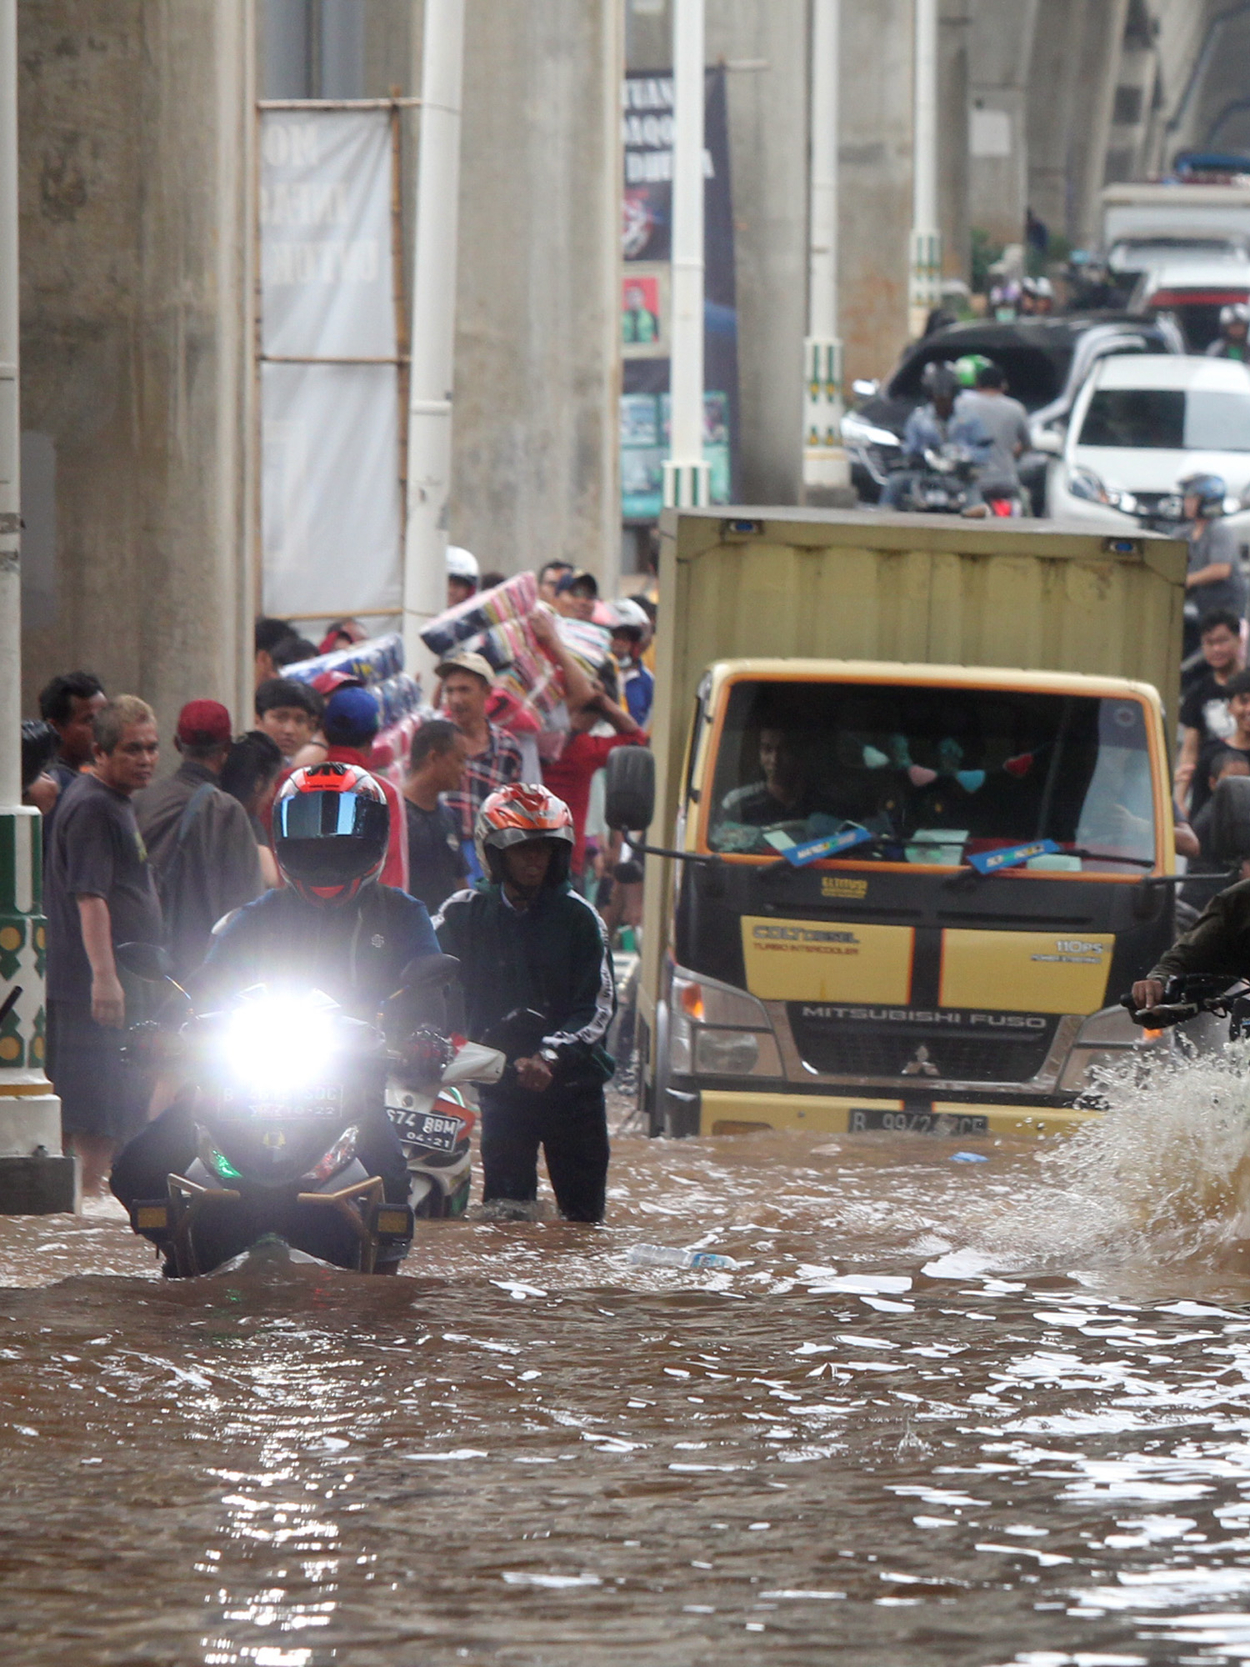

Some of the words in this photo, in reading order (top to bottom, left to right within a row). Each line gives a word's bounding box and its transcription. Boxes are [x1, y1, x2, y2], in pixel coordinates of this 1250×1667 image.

[1056, 940, 1103, 954] 110PS
[803, 1006, 961, 1024] MITSUBISHI
[970, 1013, 1046, 1029] FUSO
